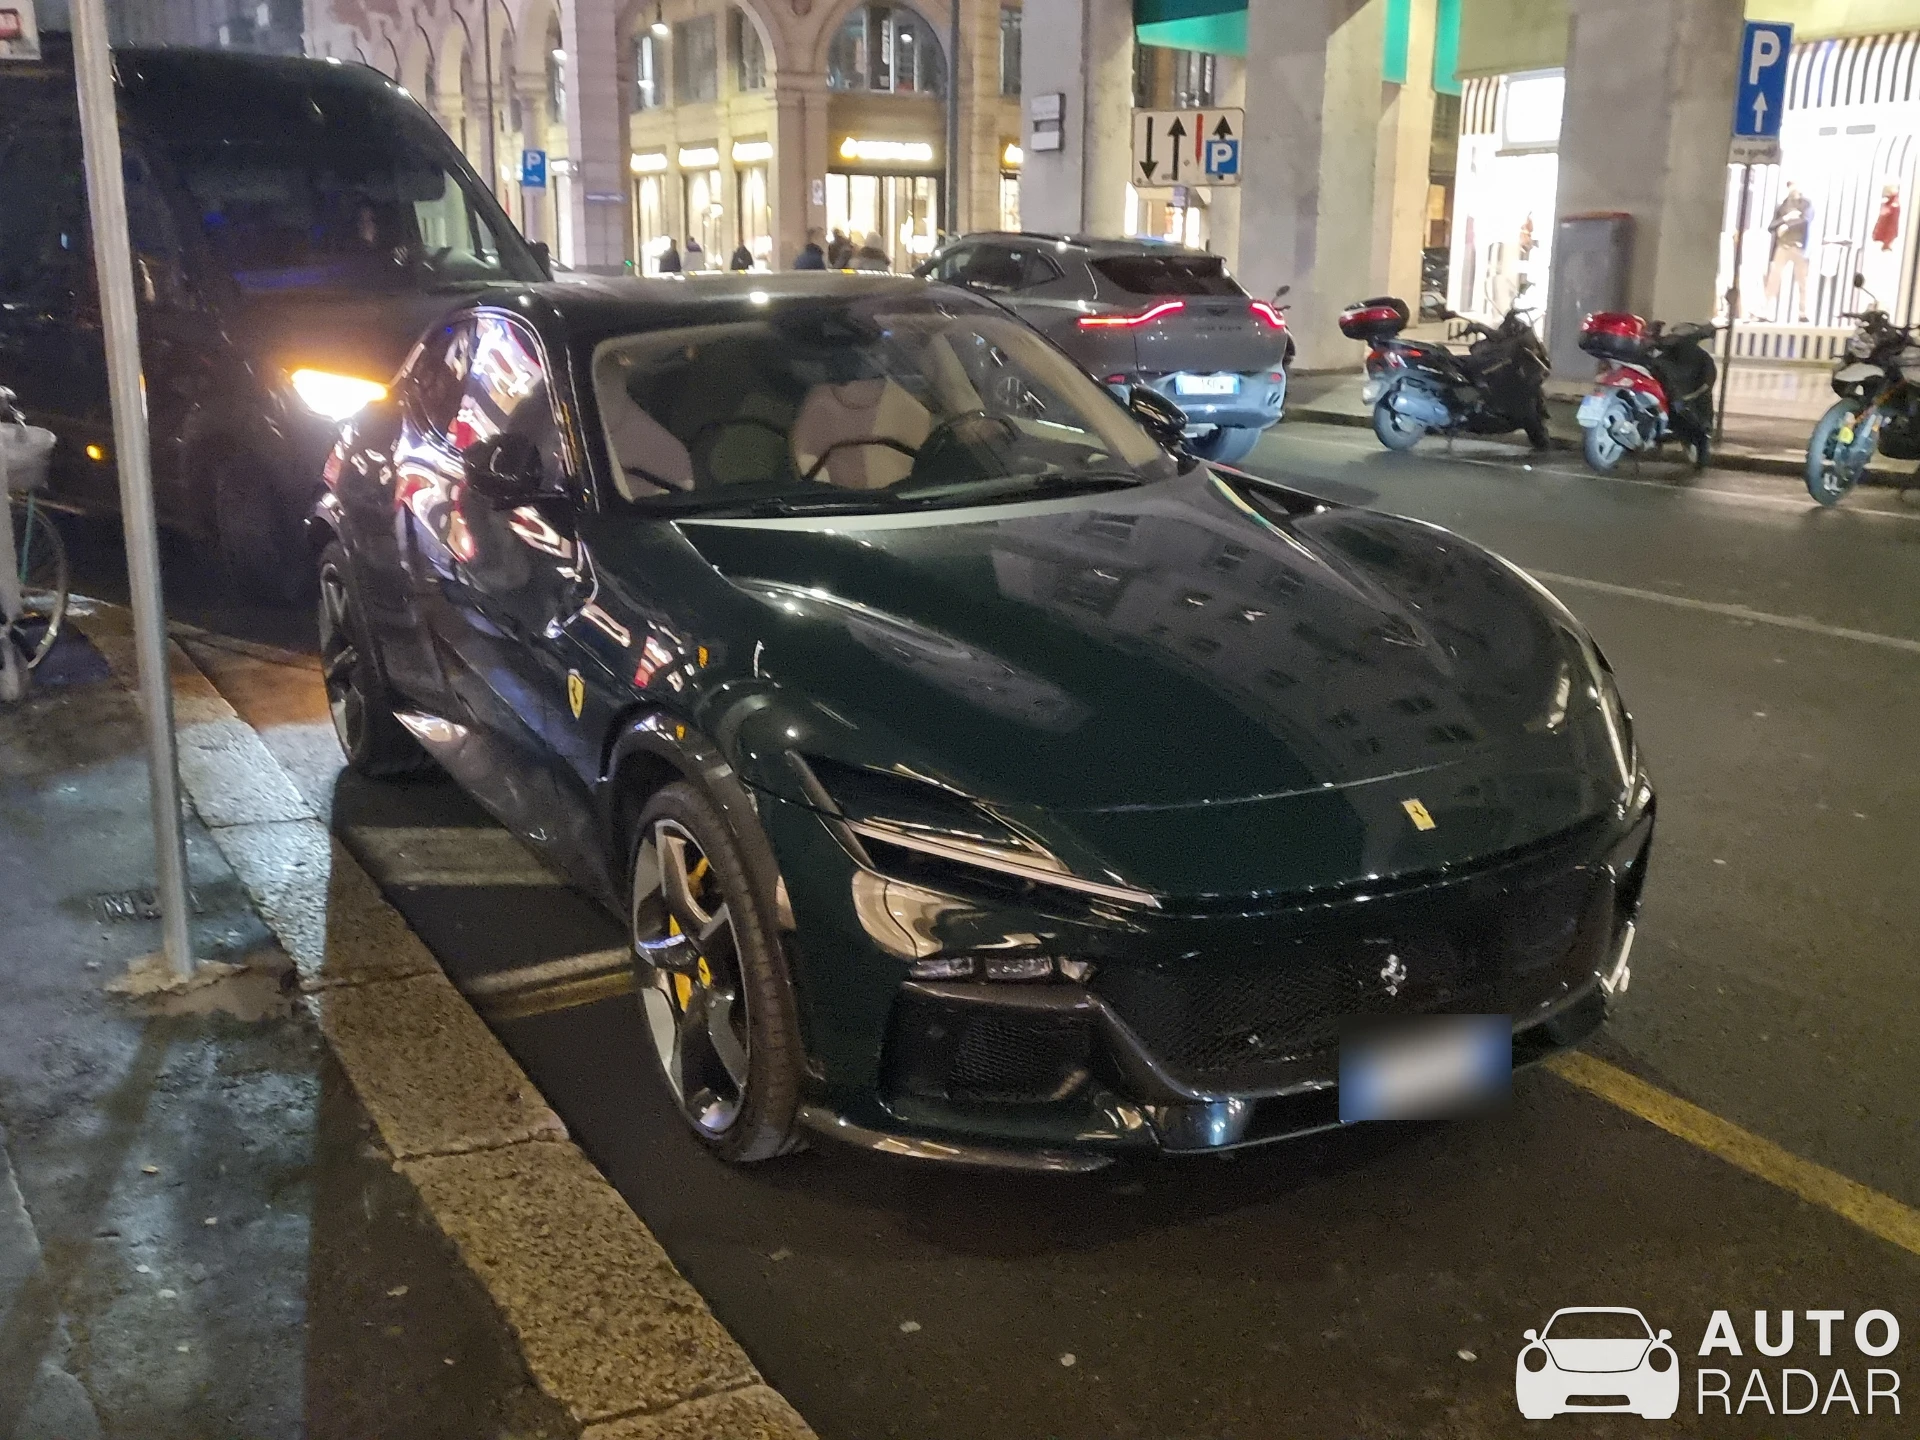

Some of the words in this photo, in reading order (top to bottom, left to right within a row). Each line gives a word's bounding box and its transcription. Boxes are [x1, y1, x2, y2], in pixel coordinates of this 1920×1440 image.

[1749, 30, 1781, 85] P
[525, 152, 542, 171] P
[1211, 143, 1233, 172] P
